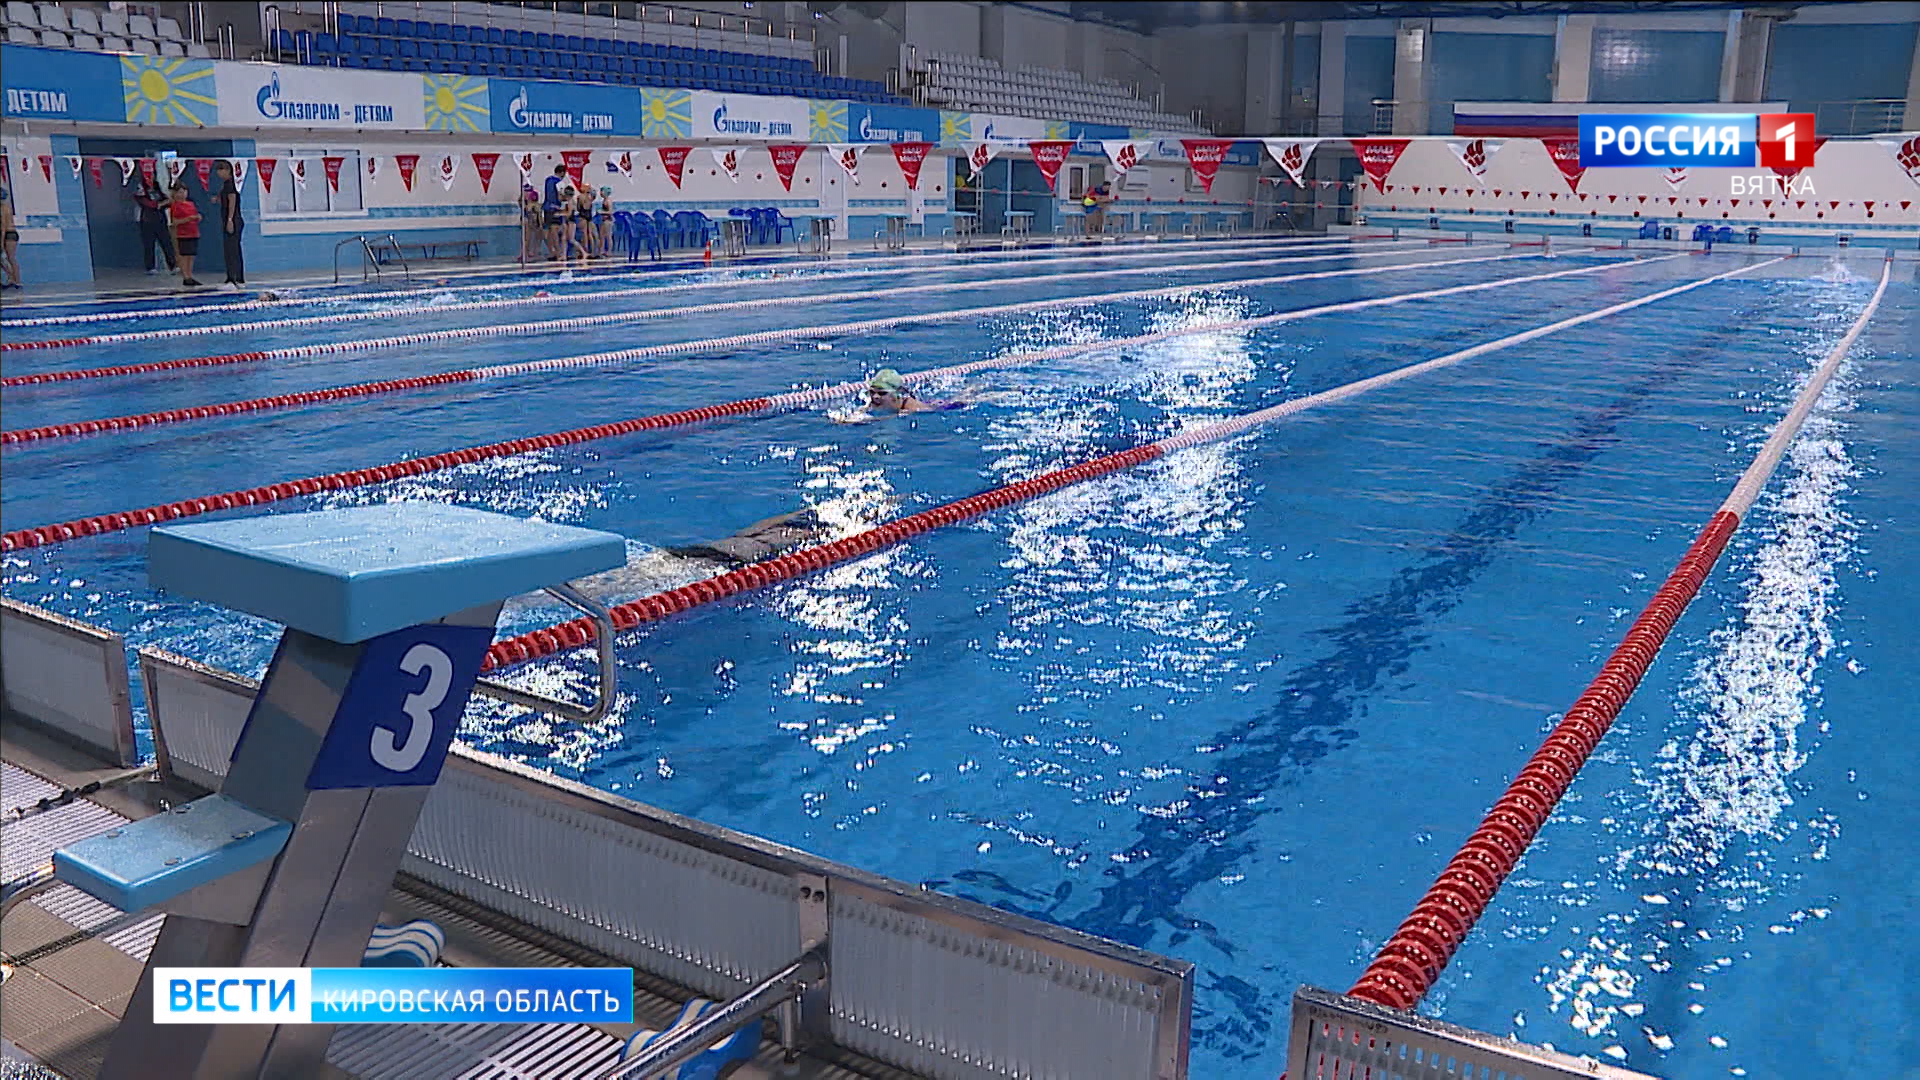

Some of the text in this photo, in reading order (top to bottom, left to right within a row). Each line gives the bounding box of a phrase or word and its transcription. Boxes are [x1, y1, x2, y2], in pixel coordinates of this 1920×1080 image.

[7, 88, 67, 114] ДЕТЯМ
[283, 102, 340, 120] ГАЗПРОМ
[354, 104, 393, 124] ДЕТЯМ
[528, 111, 572, 129] ГАЗПРОМ
[583, 114, 613, 131] ДЕТЯМ
[370, 643, 453, 772] 3
